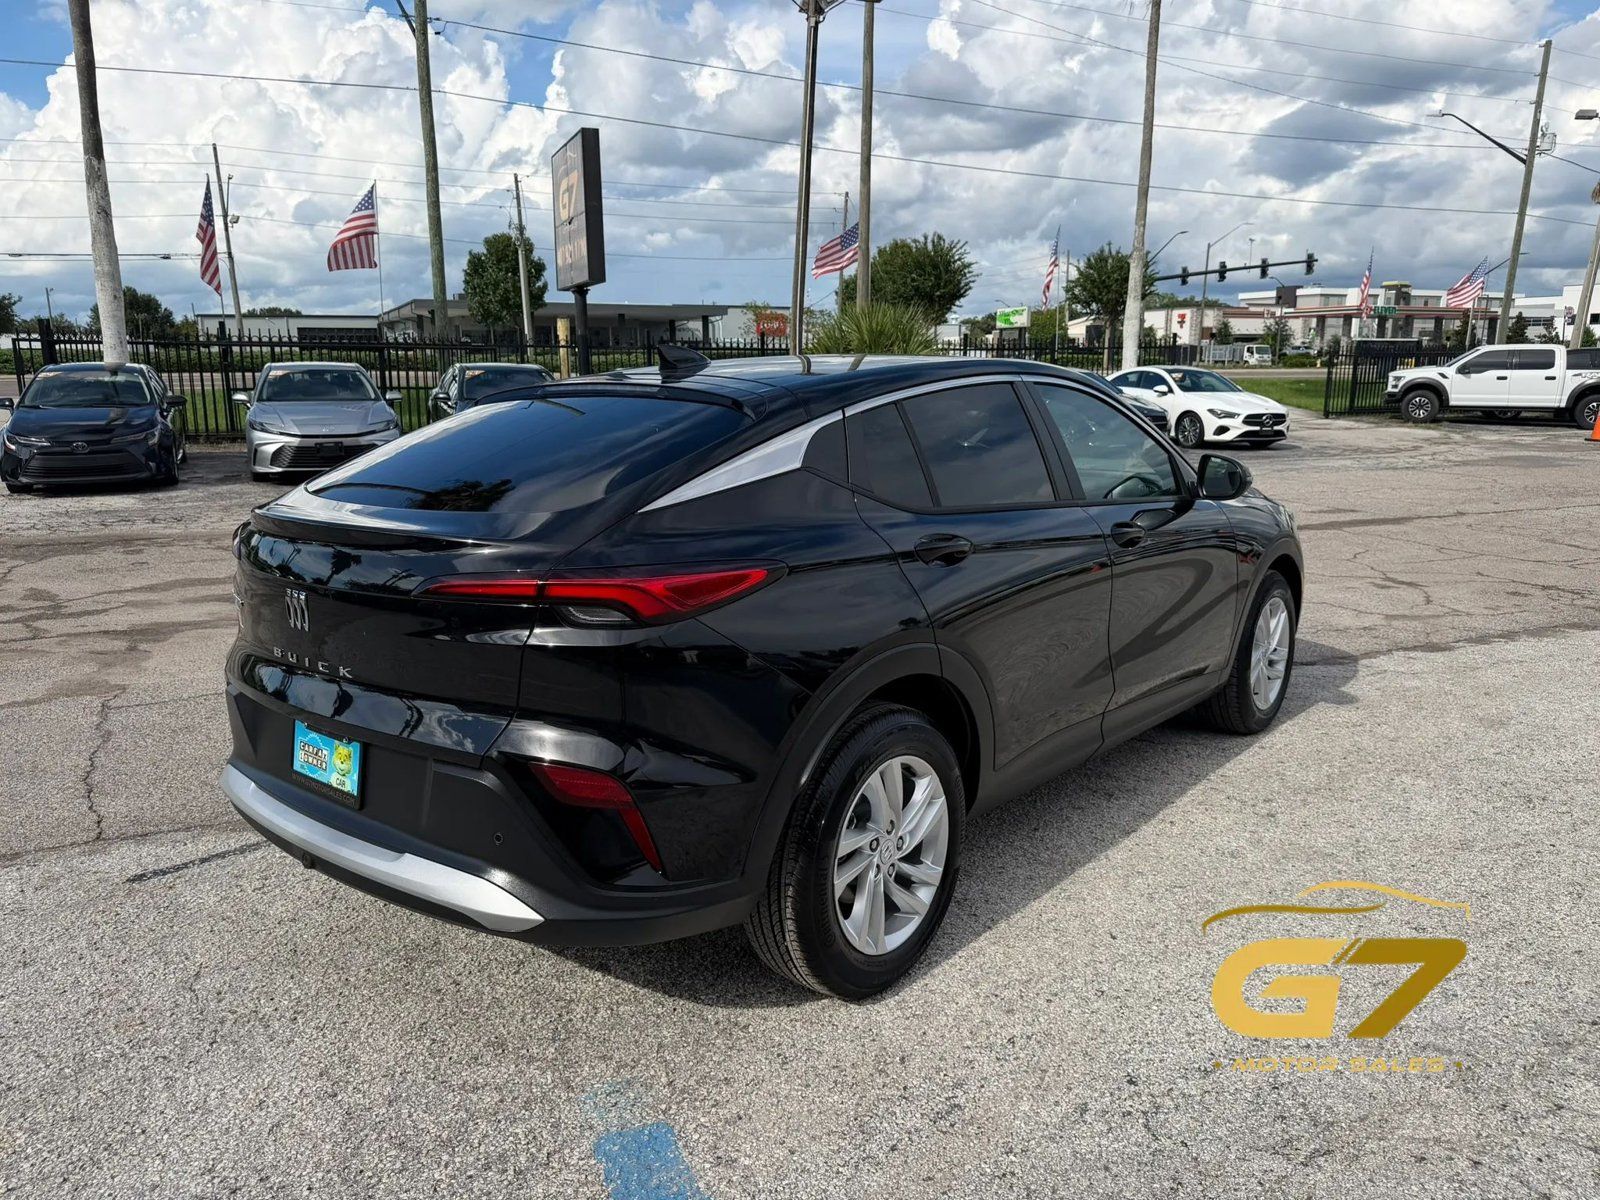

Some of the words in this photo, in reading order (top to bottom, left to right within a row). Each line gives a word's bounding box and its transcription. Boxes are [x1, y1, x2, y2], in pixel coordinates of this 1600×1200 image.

[560, 170, 579, 222] G7
[274, 647, 353, 679] BUICK
[300, 741, 328, 761] CARFAX
[303, 754, 328, 771] OWNER
[335, 778, 346, 789] CAR
